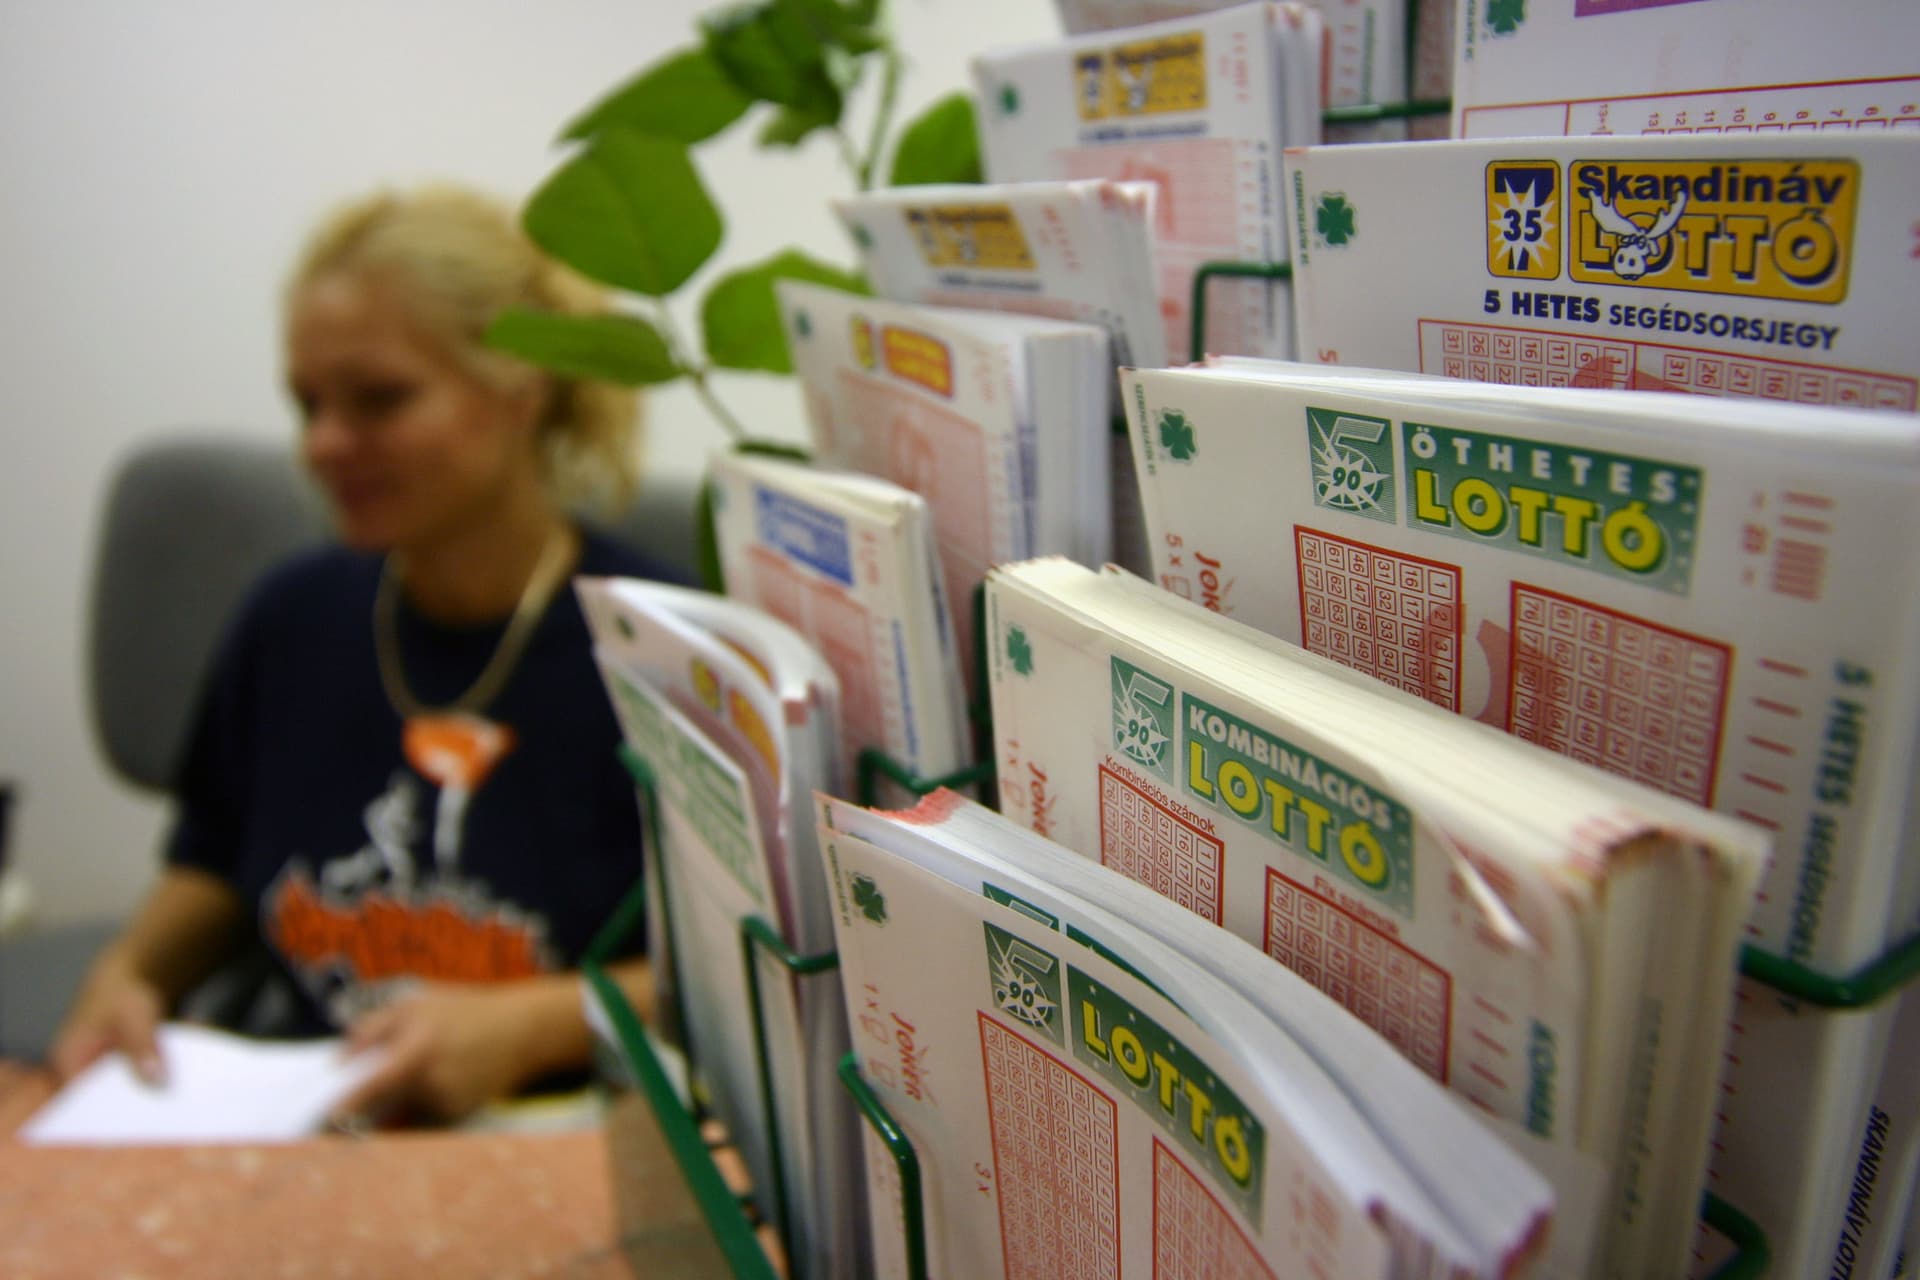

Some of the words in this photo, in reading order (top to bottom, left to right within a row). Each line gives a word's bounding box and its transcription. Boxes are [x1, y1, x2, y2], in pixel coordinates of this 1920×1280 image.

[1578, 163, 1846, 206] Skandináv
[1503, 209, 1542, 242] 35
[1484, 290, 1500, 313] 5
[1512, 291, 1600, 323] HETES
[1609, 299, 1840, 350] SEGÉDSORSJEGY
[1333, 467, 1360, 488] 90
[1410, 426, 1675, 502] ÖTHETES
[1166, 533, 1183, 548] 5
[1414, 469, 1666, 575] LOTTÓ
[1129, 719, 1149, 742] 90
[1105, 755, 1168, 806] Kombinációs
[1170, 799, 1216, 834] számok
[1190, 740, 1391, 892] LOTTÓ
[1009, 981, 1033, 1006] 90
[1083, 1000, 1250, 1188] LOTTÓ
[1846, 1105, 1892, 1237] SKANDINÁV
